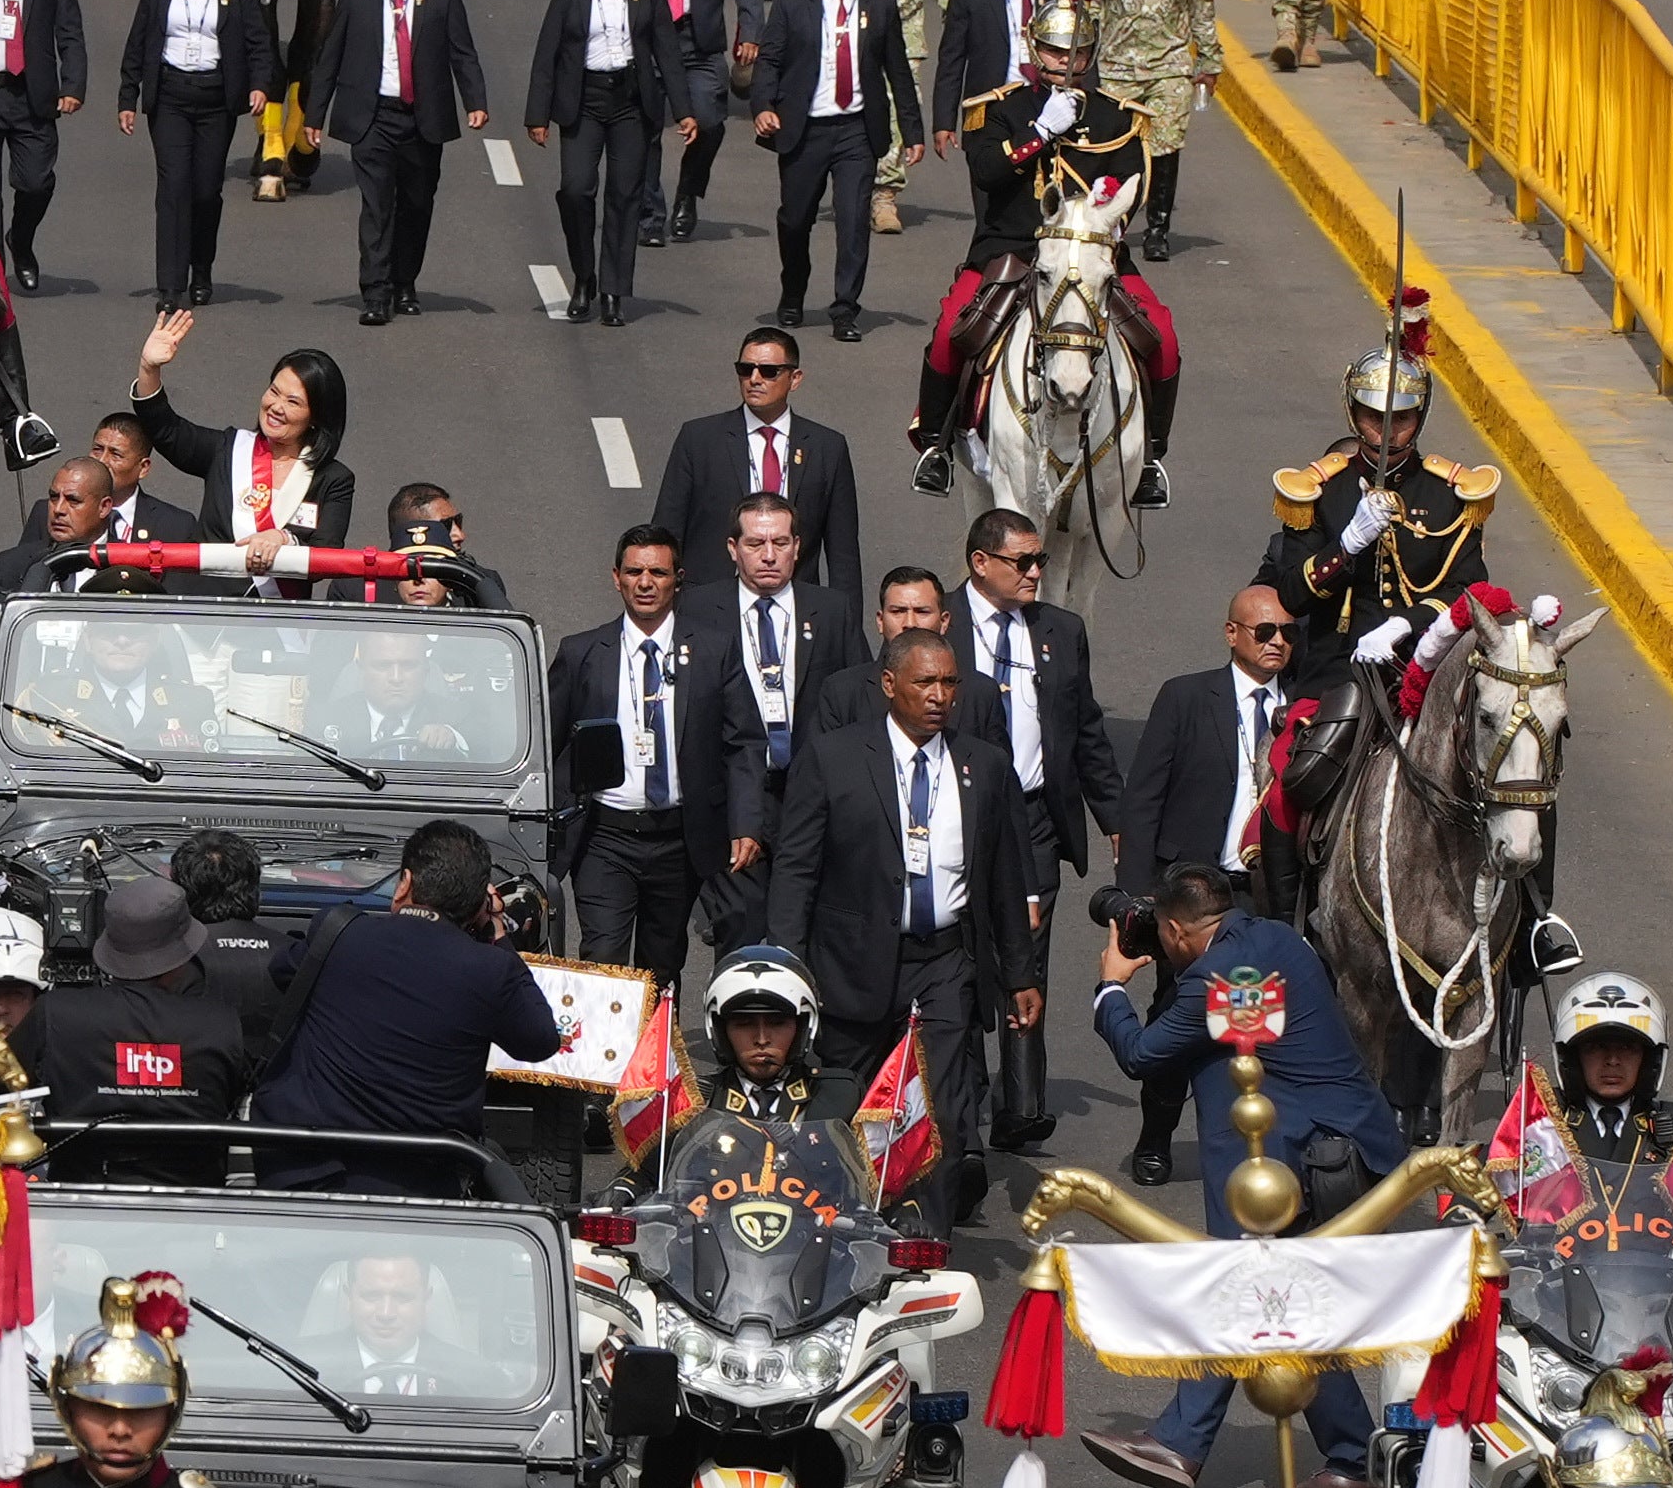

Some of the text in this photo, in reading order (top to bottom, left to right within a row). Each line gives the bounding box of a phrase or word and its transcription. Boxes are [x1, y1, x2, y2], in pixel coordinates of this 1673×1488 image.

[399, 907, 440, 922] Canon
[216, 938, 270, 949] STEADICAM
[126, 1047, 174, 1082] irtp
[687, 1172, 841, 1228] POLICIA
